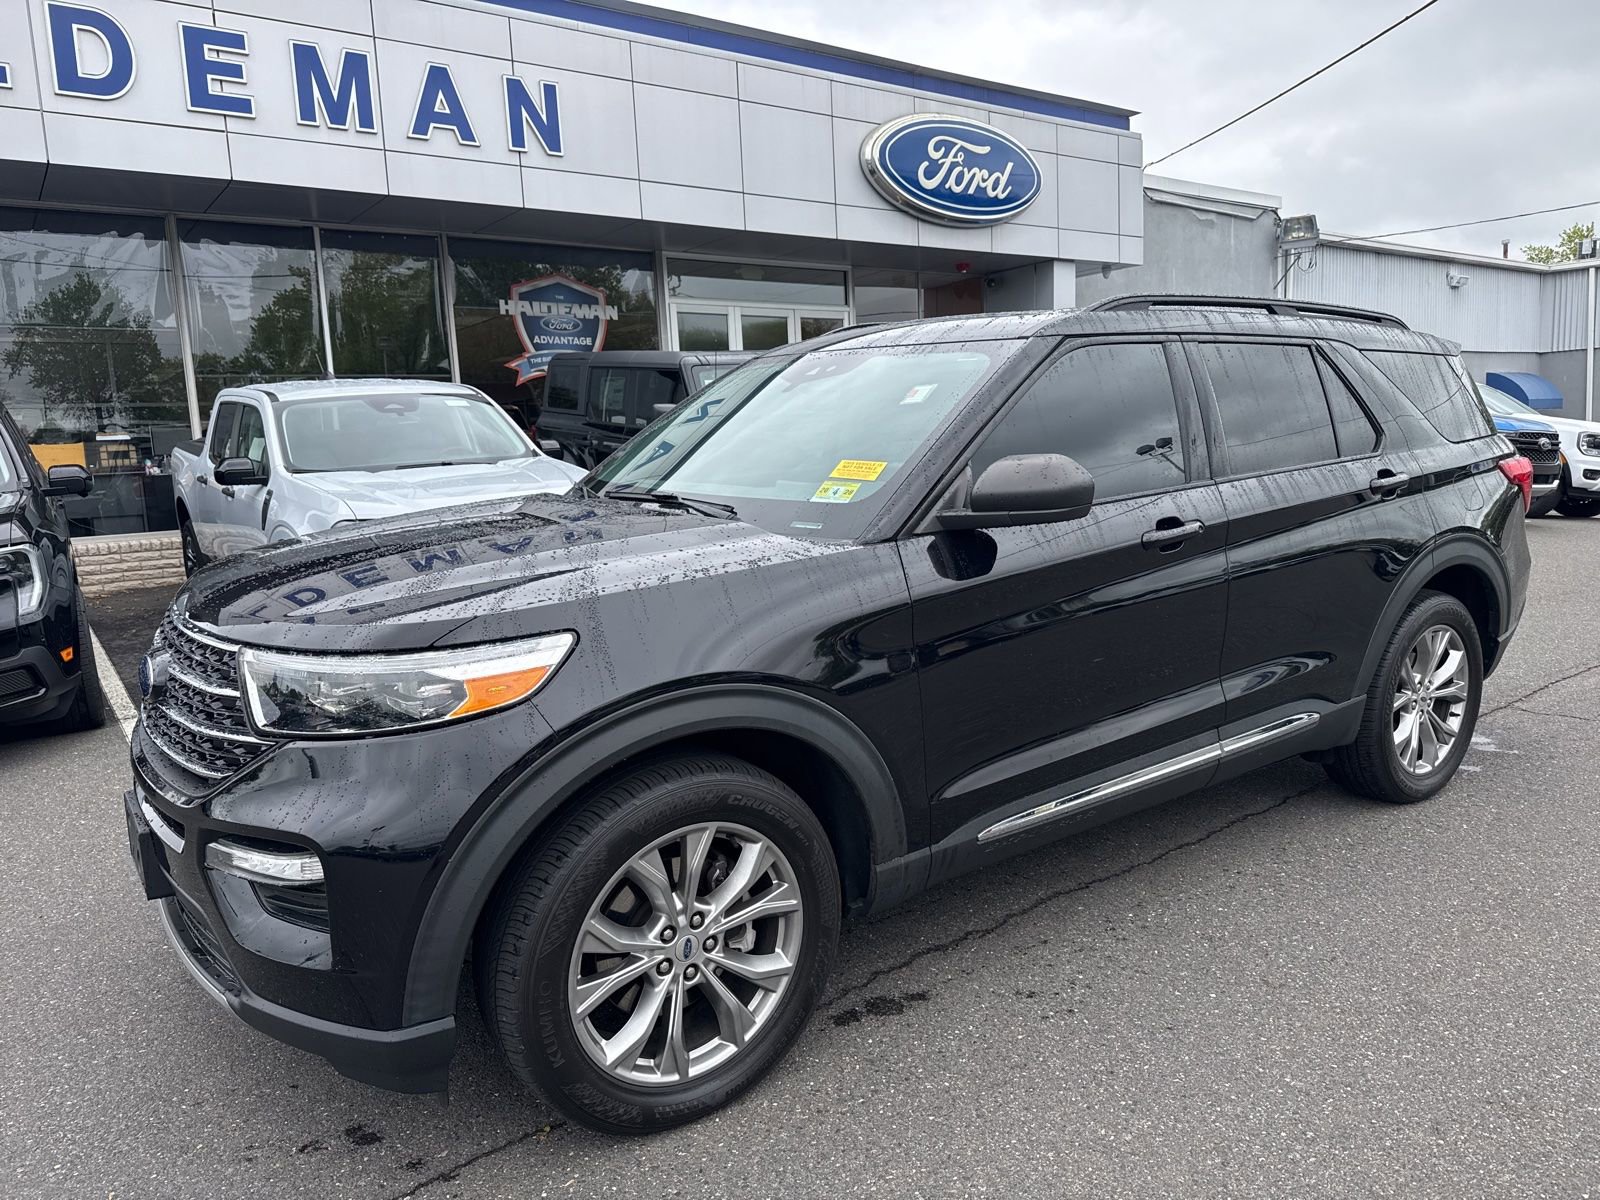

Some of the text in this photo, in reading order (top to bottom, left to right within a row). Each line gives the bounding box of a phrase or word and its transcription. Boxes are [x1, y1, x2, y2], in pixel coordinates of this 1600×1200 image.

[0, 1, 564, 157] DEMAN
[917, 135, 1014, 200] Ford
[499, 299, 619, 320] HALDEMAN
[548, 318, 574, 330] Ford
[533, 335, 593, 346] ADVANTAGE
[537, 980, 566, 1069] KUMHO
